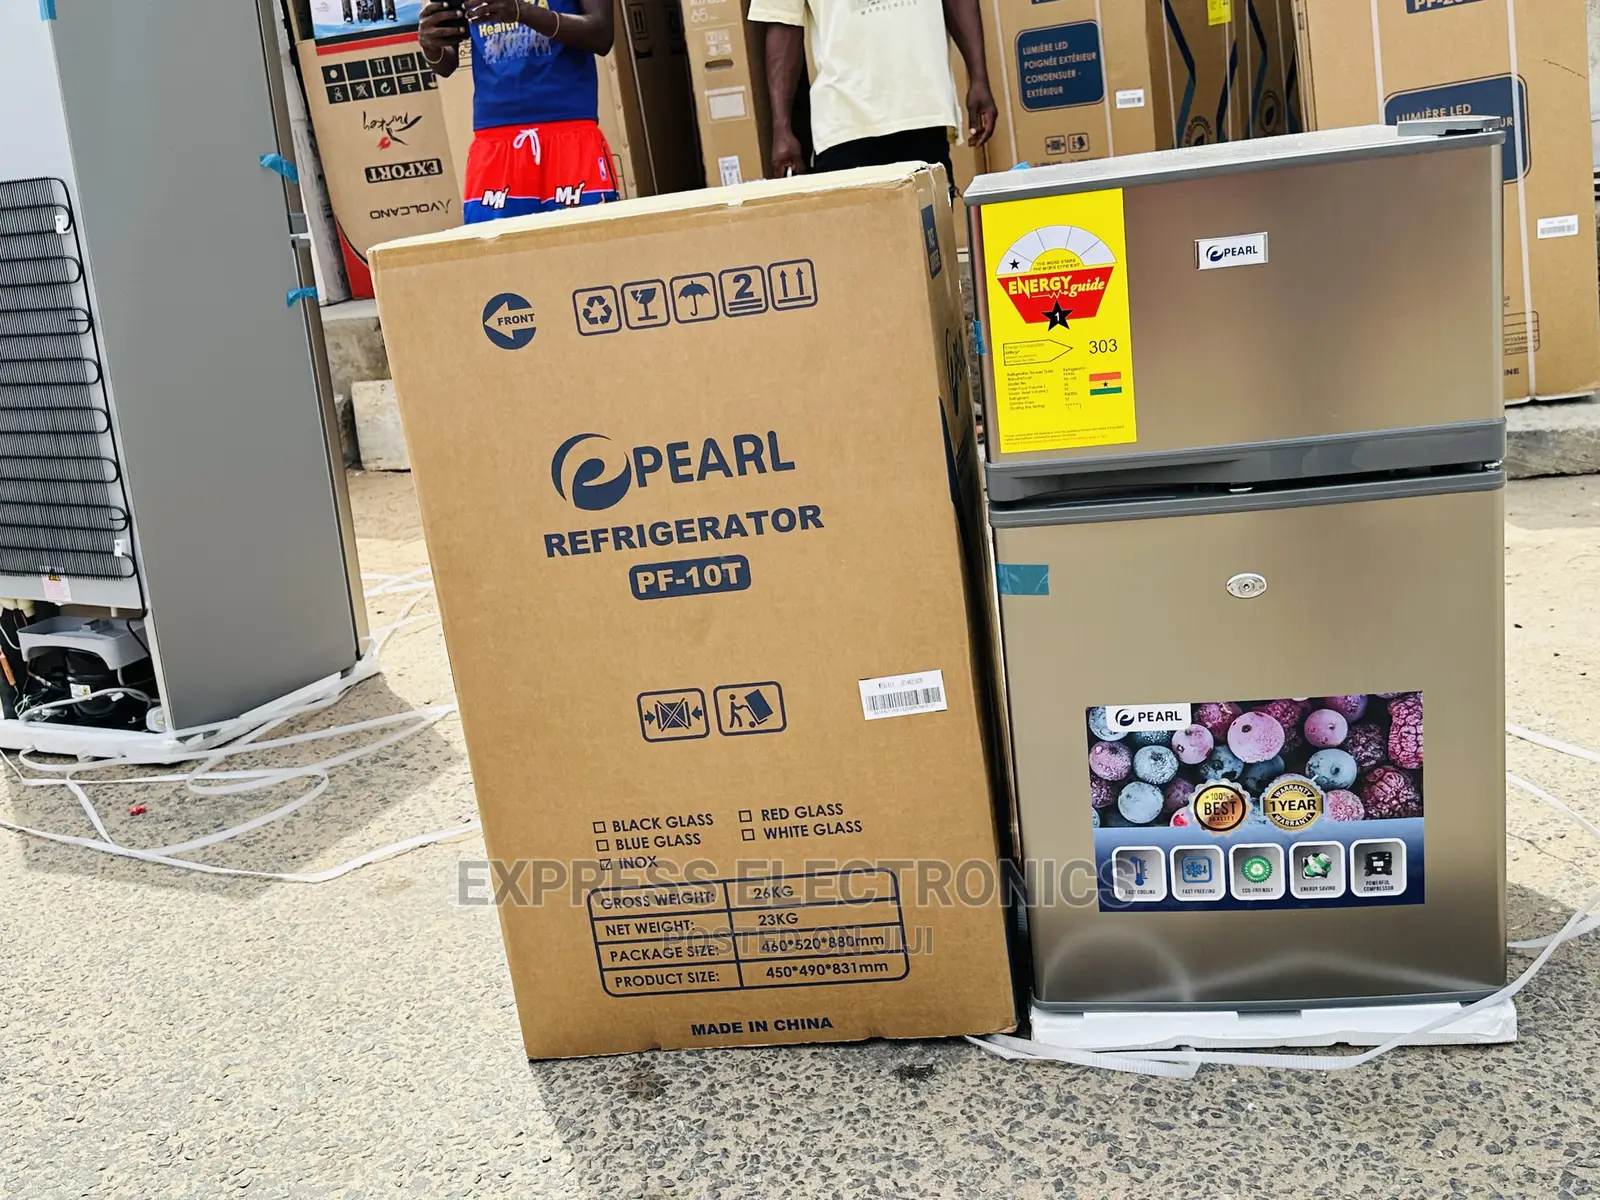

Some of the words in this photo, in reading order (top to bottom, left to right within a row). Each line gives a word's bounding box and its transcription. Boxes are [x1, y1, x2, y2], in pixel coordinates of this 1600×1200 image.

[1055, 41, 1068, 51] LED
[1449, 103, 1472, 116] LED
[368, 159, 440, 182] EXPORT
[369, 202, 440, 220] VOLCANO
[1223, 245, 1258, 257] PEARL
[1008, 275, 1072, 299] ENERGY
[1068, 277, 1105, 297] guide
[497, 312, 535, 327] FRONT
[1054, 311, 1060, 322] 1
[1088, 338, 1118, 354] 303
[632, 430, 796, 488] PEARL
[543, 504, 825, 558] REFRIGERATOR
[636, 562, 743, 594] PF-10T
[1138, 710, 1182, 722] PEARL
[1210, 792, 1229, 801] 100%
[1273, 784, 1313, 797] WARRANTY
[761, 807, 789, 822] RED
[794, 803, 844, 819] GLASS
[1204, 801, 1237, 816] BEST
[1270, 801, 1276, 811] 1
[1278, 799, 1317, 811] YEAR
[612, 816, 662, 833] BLACK
[665, 813, 714, 829] GLASS
[1273, 814, 1313, 827] WARRANTY
[763, 824, 809, 841] WHITE
[813, 820, 863, 836] GLASS
[615, 836, 650, 851] BLUE
[653, 833, 702, 849] GLASS
[618, 855, 659, 870] INOX
[601, 895, 651, 910] GROSS
[654, 891, 716, 907] WEIGHT:
[753, 886, 794, 901] 26KG
[605, 923, 633, 937] NET
[634, 919, 695, 935] WEIGHT:
[758, 912, 799, 927] 23KG
[610, 947, 683, 963] PACKAGE
[686, 944, 720, 958] SIZE:
[615, 972, 683, 988] PRODUCT
[686, 970, 721, 984] SIZE:
[691, 1021, 744, 1036] MADE
[749, 1020, 769, 1033] IN
[773, 1016, 834, 1032] CHINA
